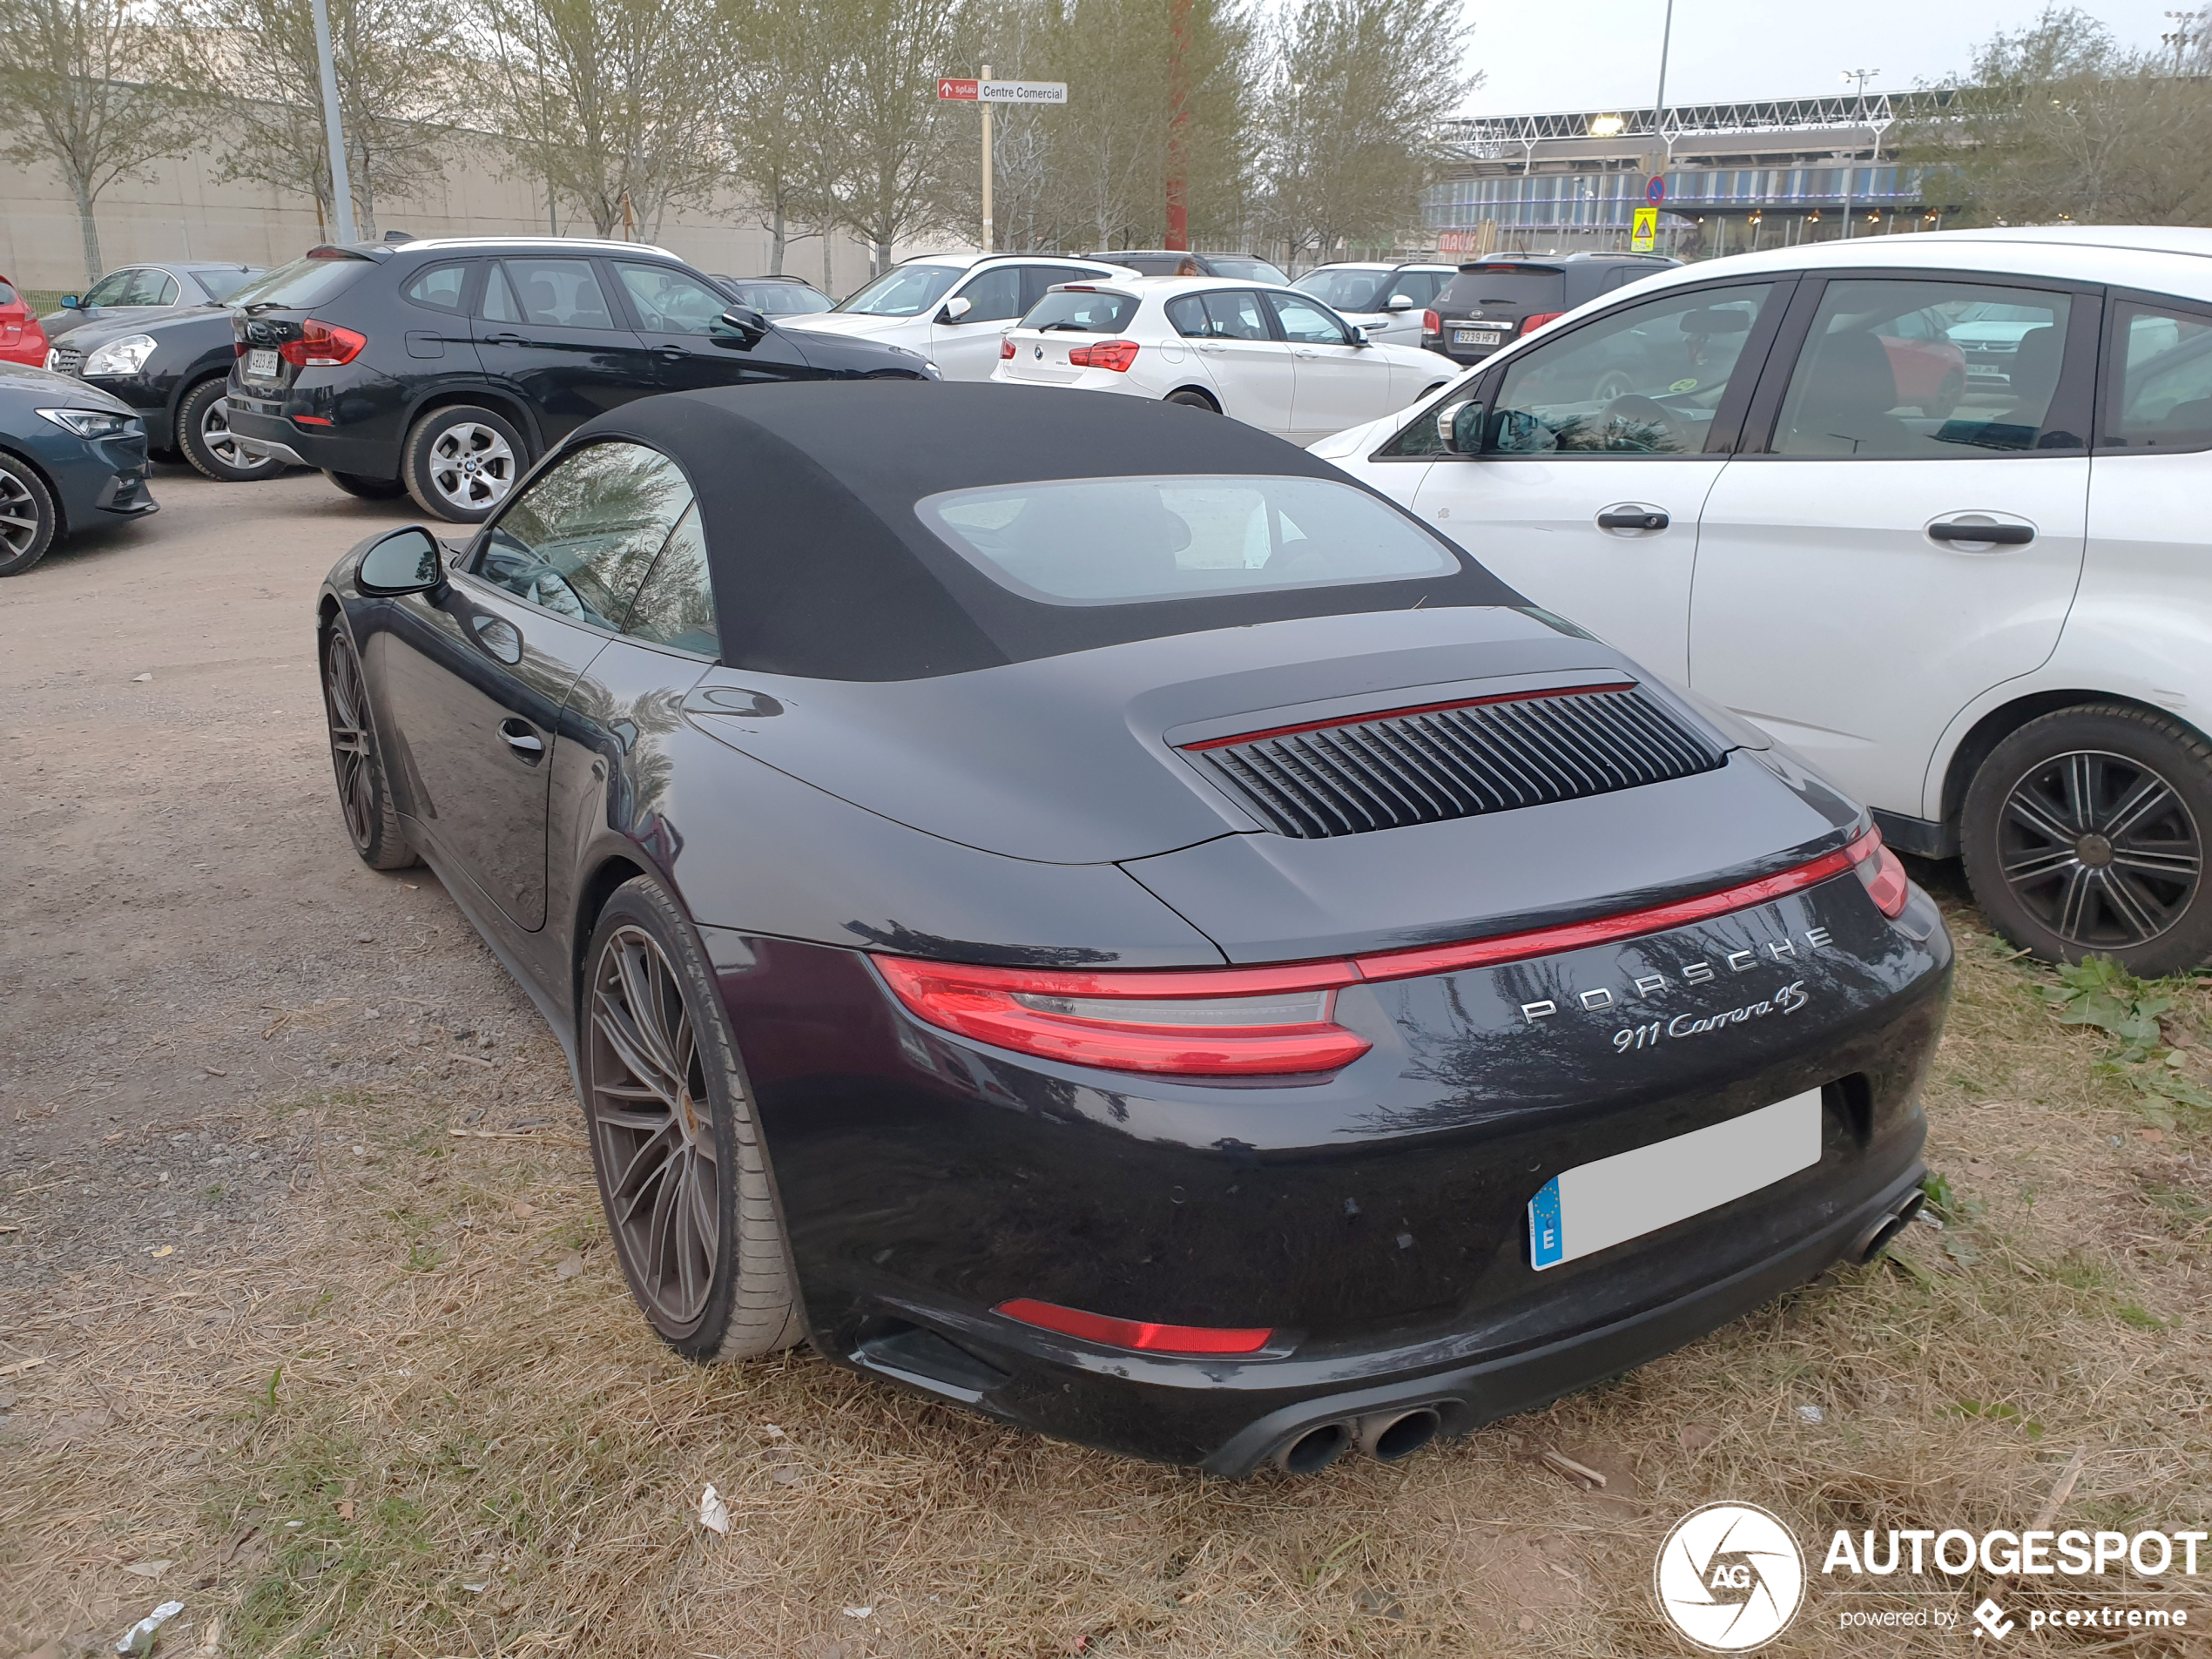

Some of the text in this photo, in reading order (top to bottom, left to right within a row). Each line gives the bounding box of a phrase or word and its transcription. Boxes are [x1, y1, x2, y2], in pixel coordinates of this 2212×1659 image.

[954, 84, 1062, 99] splau Centre Comercial
[1460, 332, 1498, 343] 9239 HFX
[1521, 927, 1833, 1024] PORSCHE
[1613, 980, 1809, 1054] 911 Carrera 4S
[1543, 1228, 1554, 1250] E
